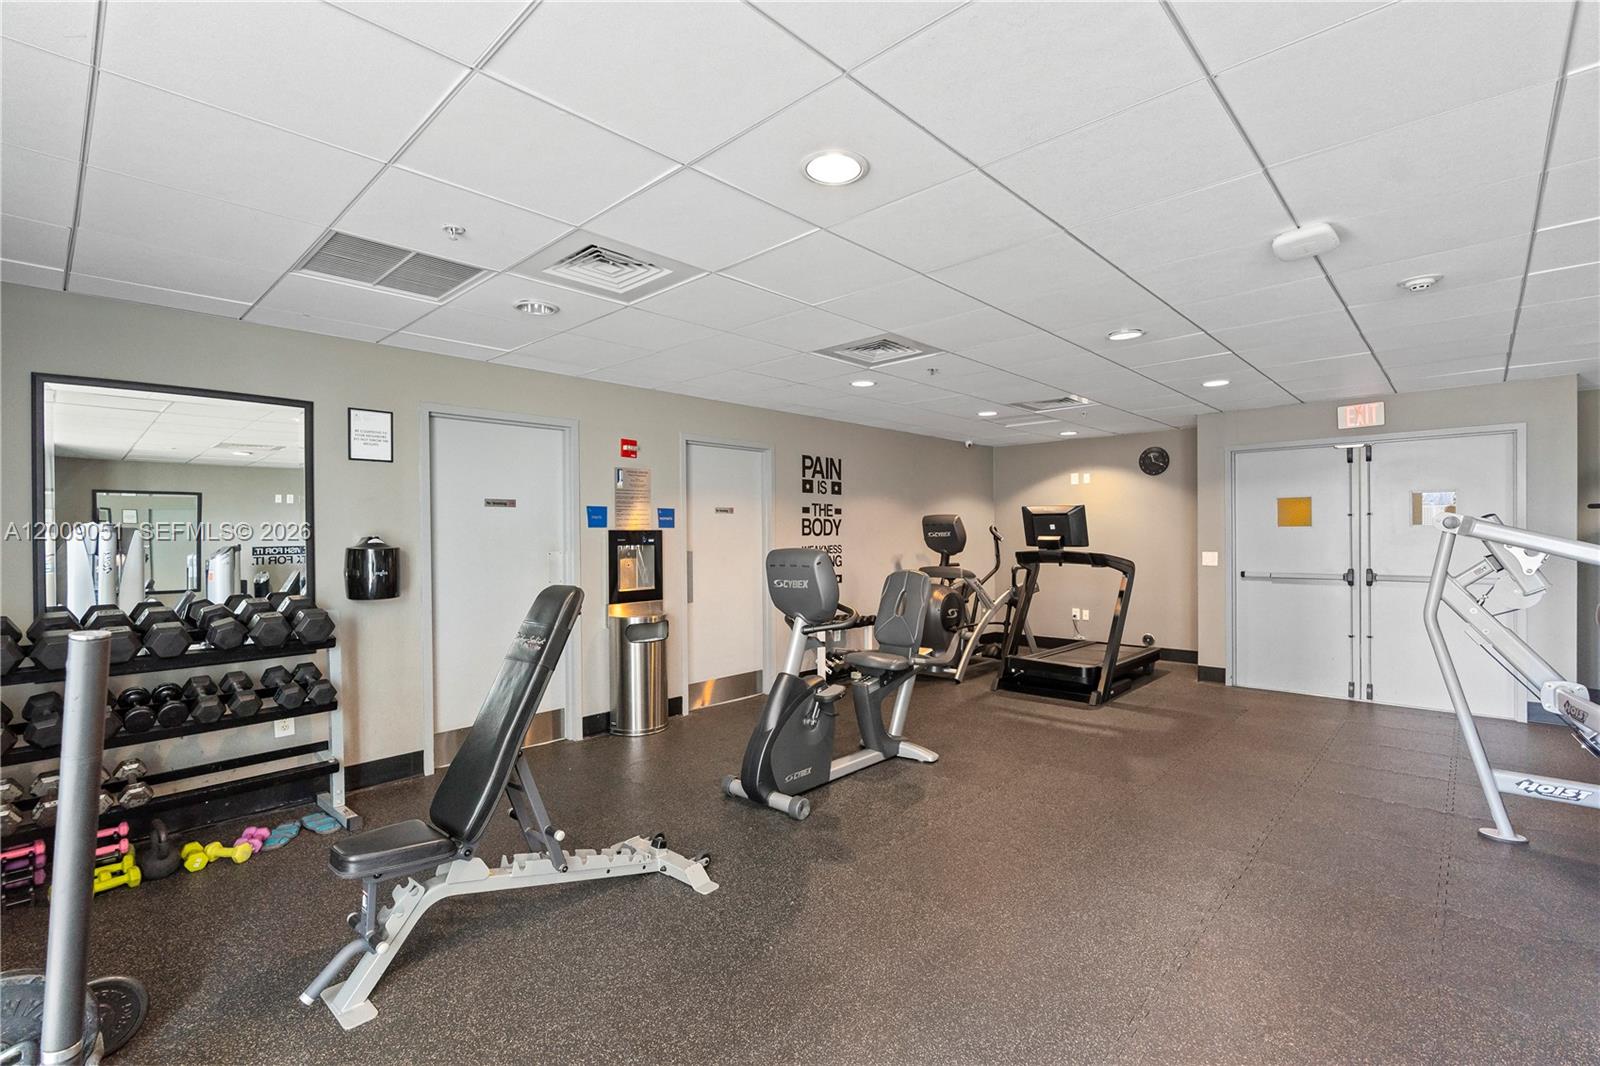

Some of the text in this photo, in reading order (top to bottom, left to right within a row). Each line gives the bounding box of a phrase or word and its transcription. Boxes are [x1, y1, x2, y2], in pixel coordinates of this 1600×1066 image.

[1346, 403, 1376, 427] EXIT
[802, 455, 841, 480] PAIN
[817, 480, 828, 494] IS
[811, 503, 833, 517] THE
[802, 518, 842, 536] BODY
[783, 579, 809, 589] CYBEX
[1516, 779, 1593, 801] HOIST
